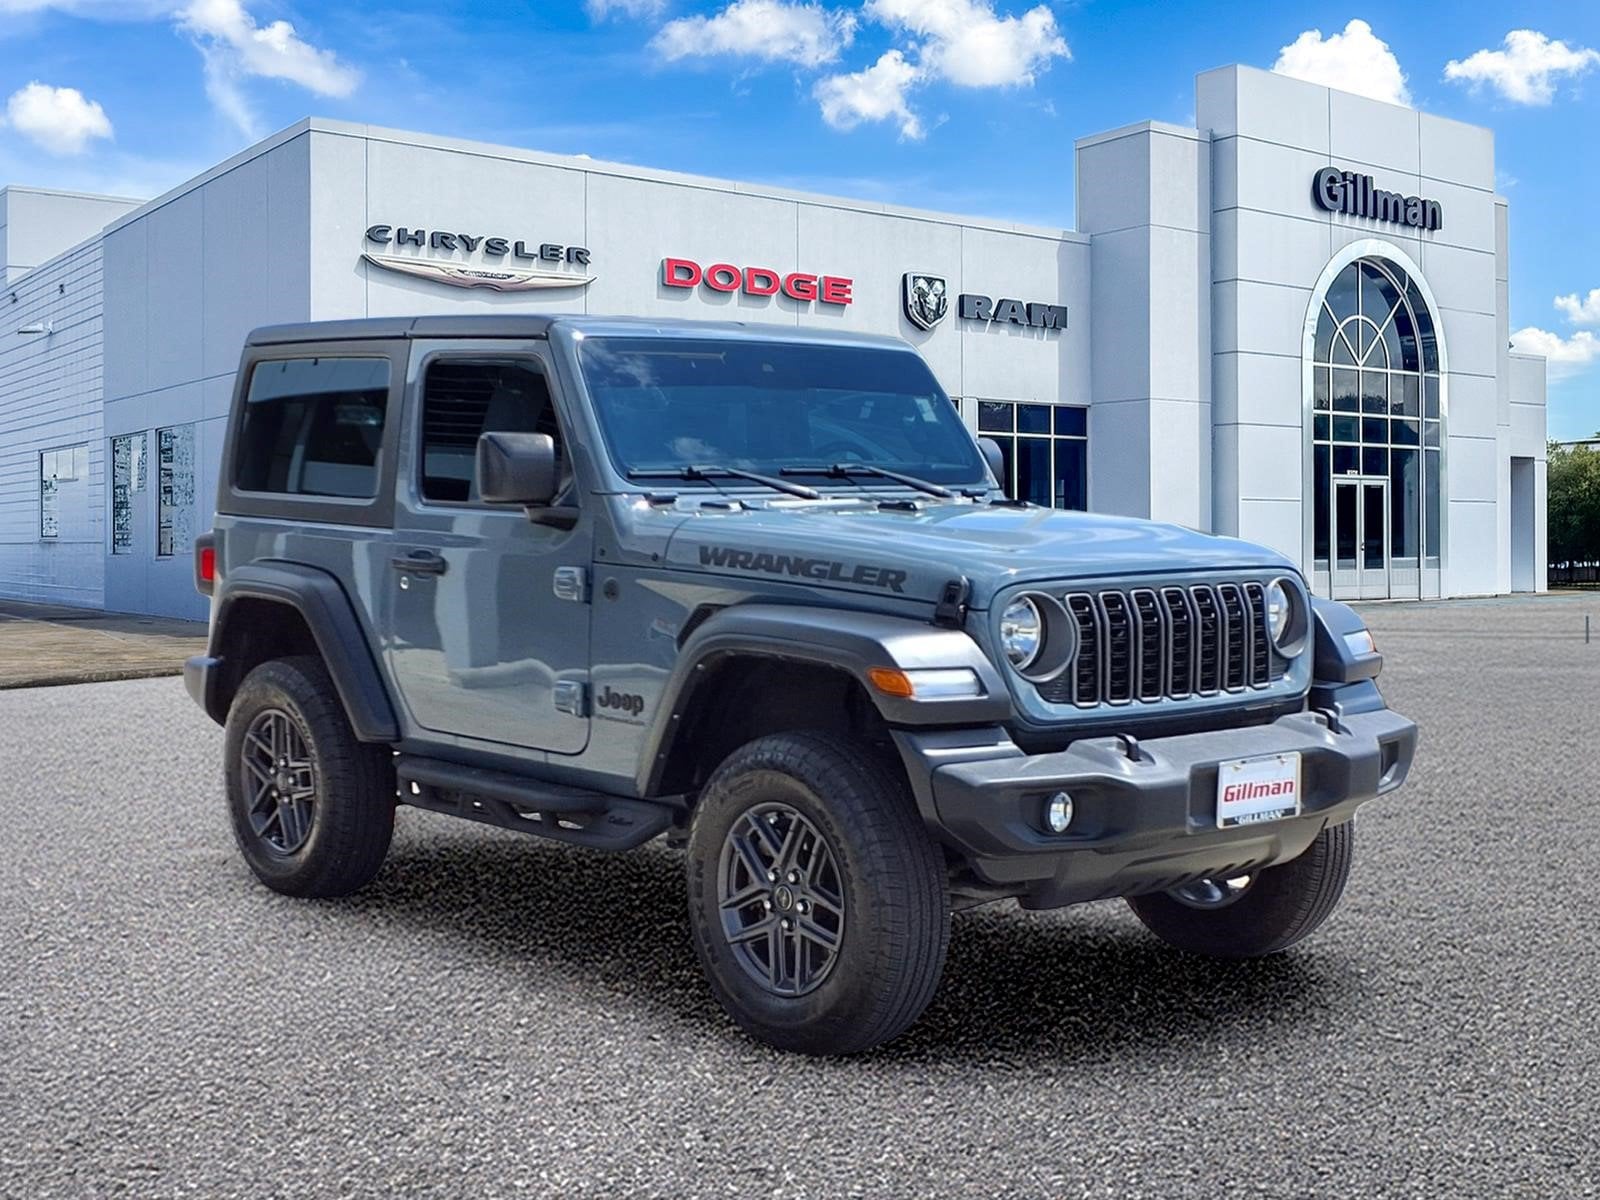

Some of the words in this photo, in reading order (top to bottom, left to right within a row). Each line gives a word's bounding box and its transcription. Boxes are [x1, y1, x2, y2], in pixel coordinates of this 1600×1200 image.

[1313, 167, 1442, 230] Gillman
[365, 224, 591, 264] CHRYSLER
[661, 257, 853, 304] DODGE
[959, 293, 1068, 330] RAM
[699, 545, 907, 593] WRANGLER
[597, 685, 644, 717] Jeep
[1223, 781, 1294, 802] Gillman
